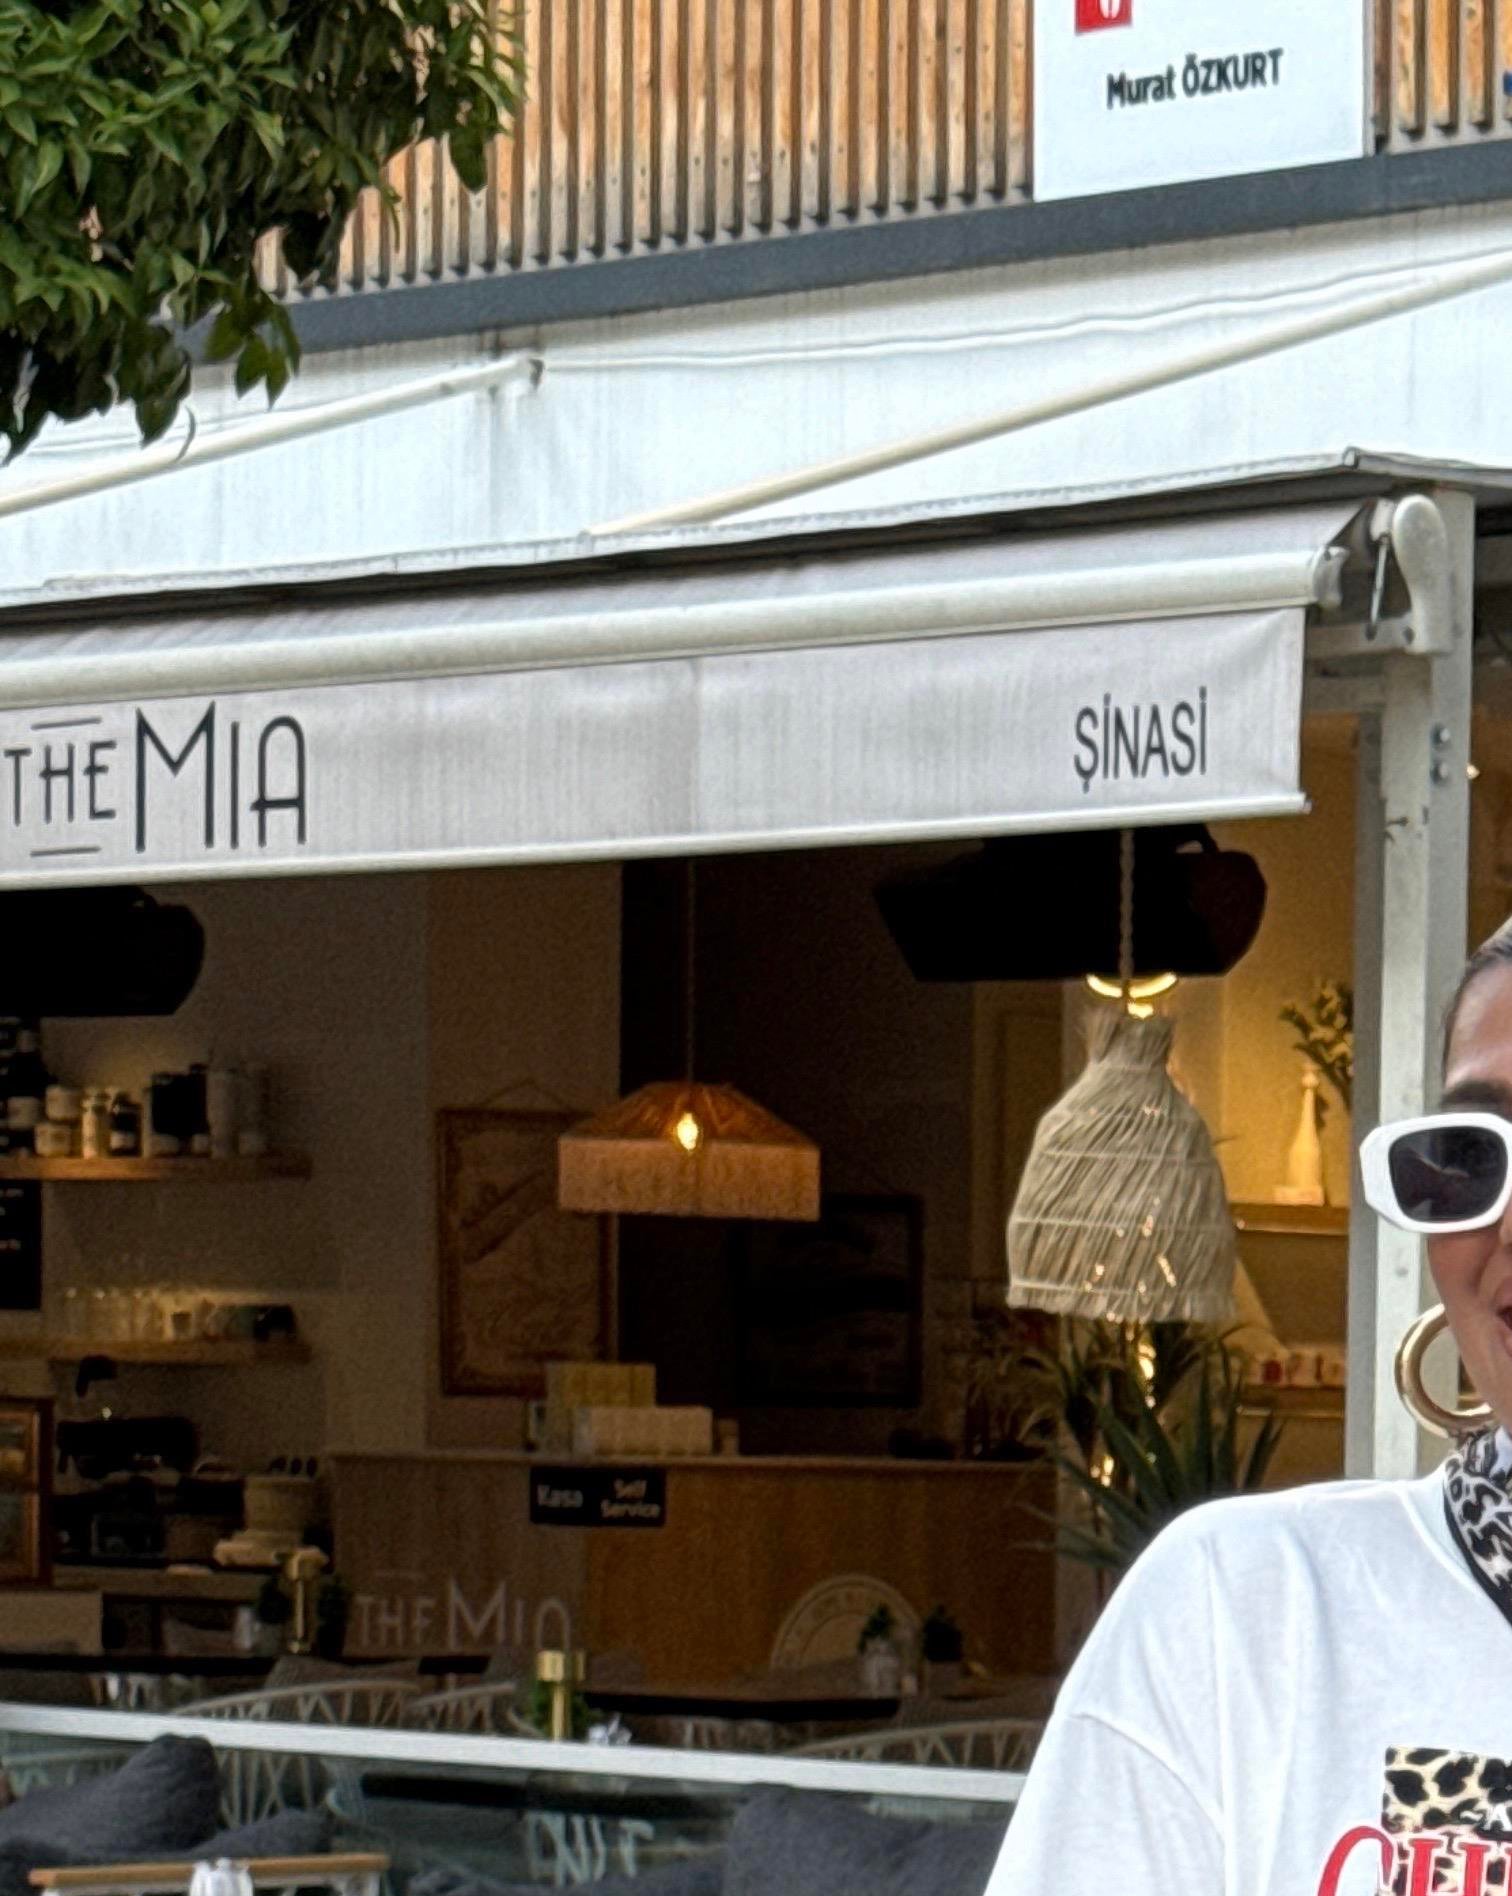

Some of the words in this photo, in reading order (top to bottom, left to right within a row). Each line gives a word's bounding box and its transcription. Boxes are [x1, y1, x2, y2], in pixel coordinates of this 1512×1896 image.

[1106, 64, 1177, 110] Murat
[1182, 47, 1284, 98] ÖZKURT
[4, 740, 117, 827] THE
[135, 700, 307, 853] MIA
[1073, 685, 1207, 794] ŞİNASİ
